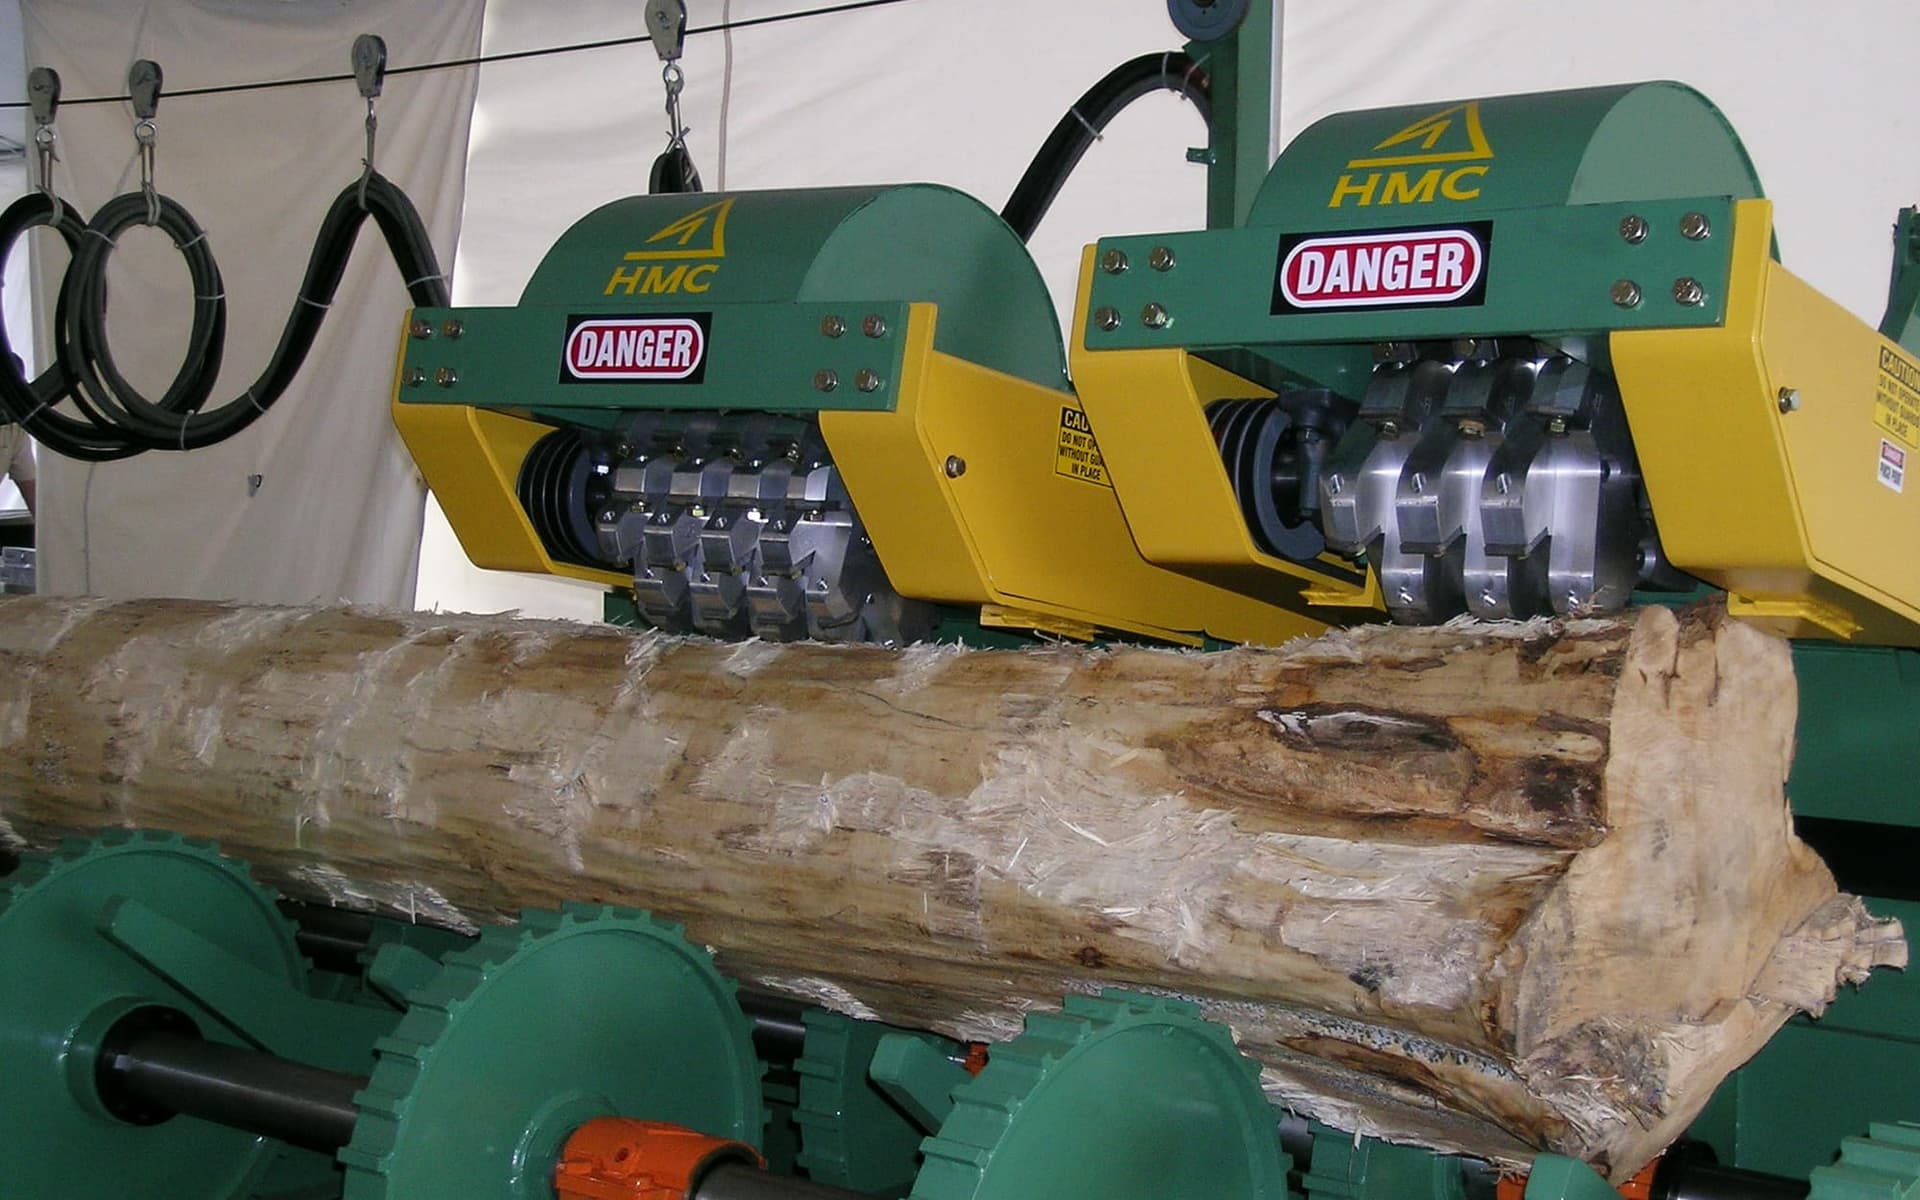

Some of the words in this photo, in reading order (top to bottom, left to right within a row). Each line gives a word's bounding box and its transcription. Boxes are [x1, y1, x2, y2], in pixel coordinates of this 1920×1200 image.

[1327, 166, 1490, 208] HMC
[603, 264, 720, 295] HMC
[1297, 243, 1466, 295] DANGER
[577, 329, 694, 367] DANGER
[1060, 446, 1089, 462] WITHOUT
[1062, 431, 1072, 443] DO
[1073, 435, 1087, 448] NOT
[1072, 463, 1079, 474] IN
[1080, 465, 1101, 480] PLACE
